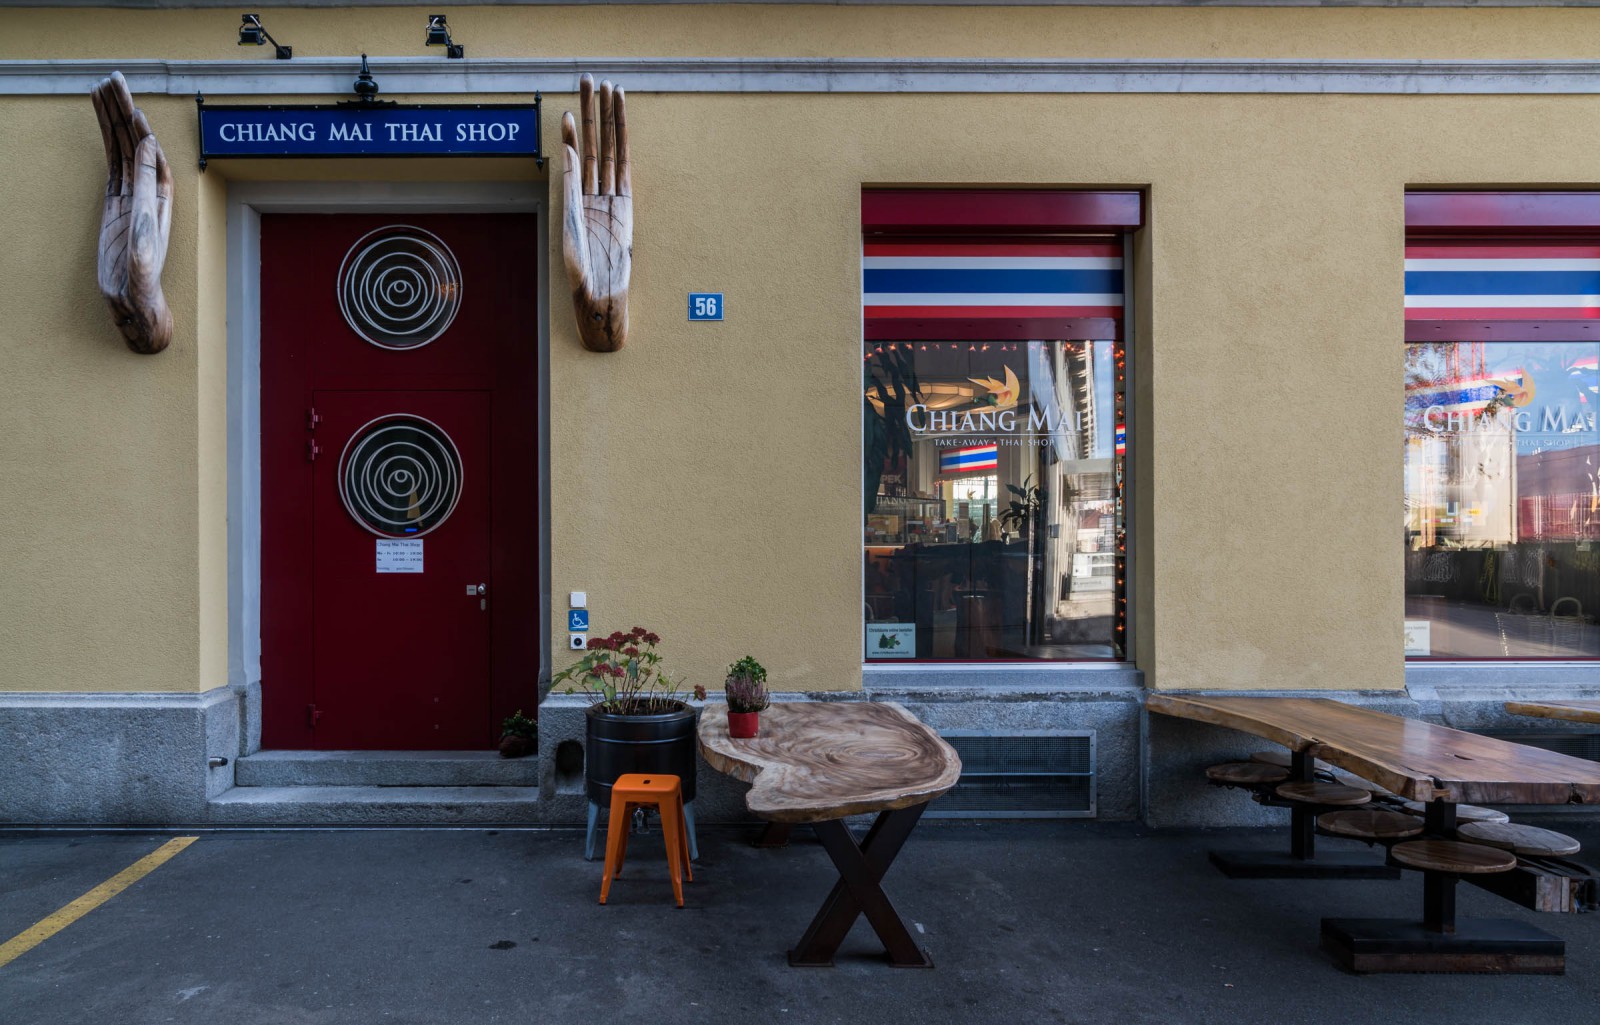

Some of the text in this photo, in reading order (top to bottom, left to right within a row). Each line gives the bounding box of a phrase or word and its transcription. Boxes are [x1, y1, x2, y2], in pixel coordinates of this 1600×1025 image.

[219, 123, 520, 142] CHIANG MAI THAI SHOP
[695, 297, 717, 316] 56
[934, 438, 1055, 447] TAKE-AWAY THAI SHOP
